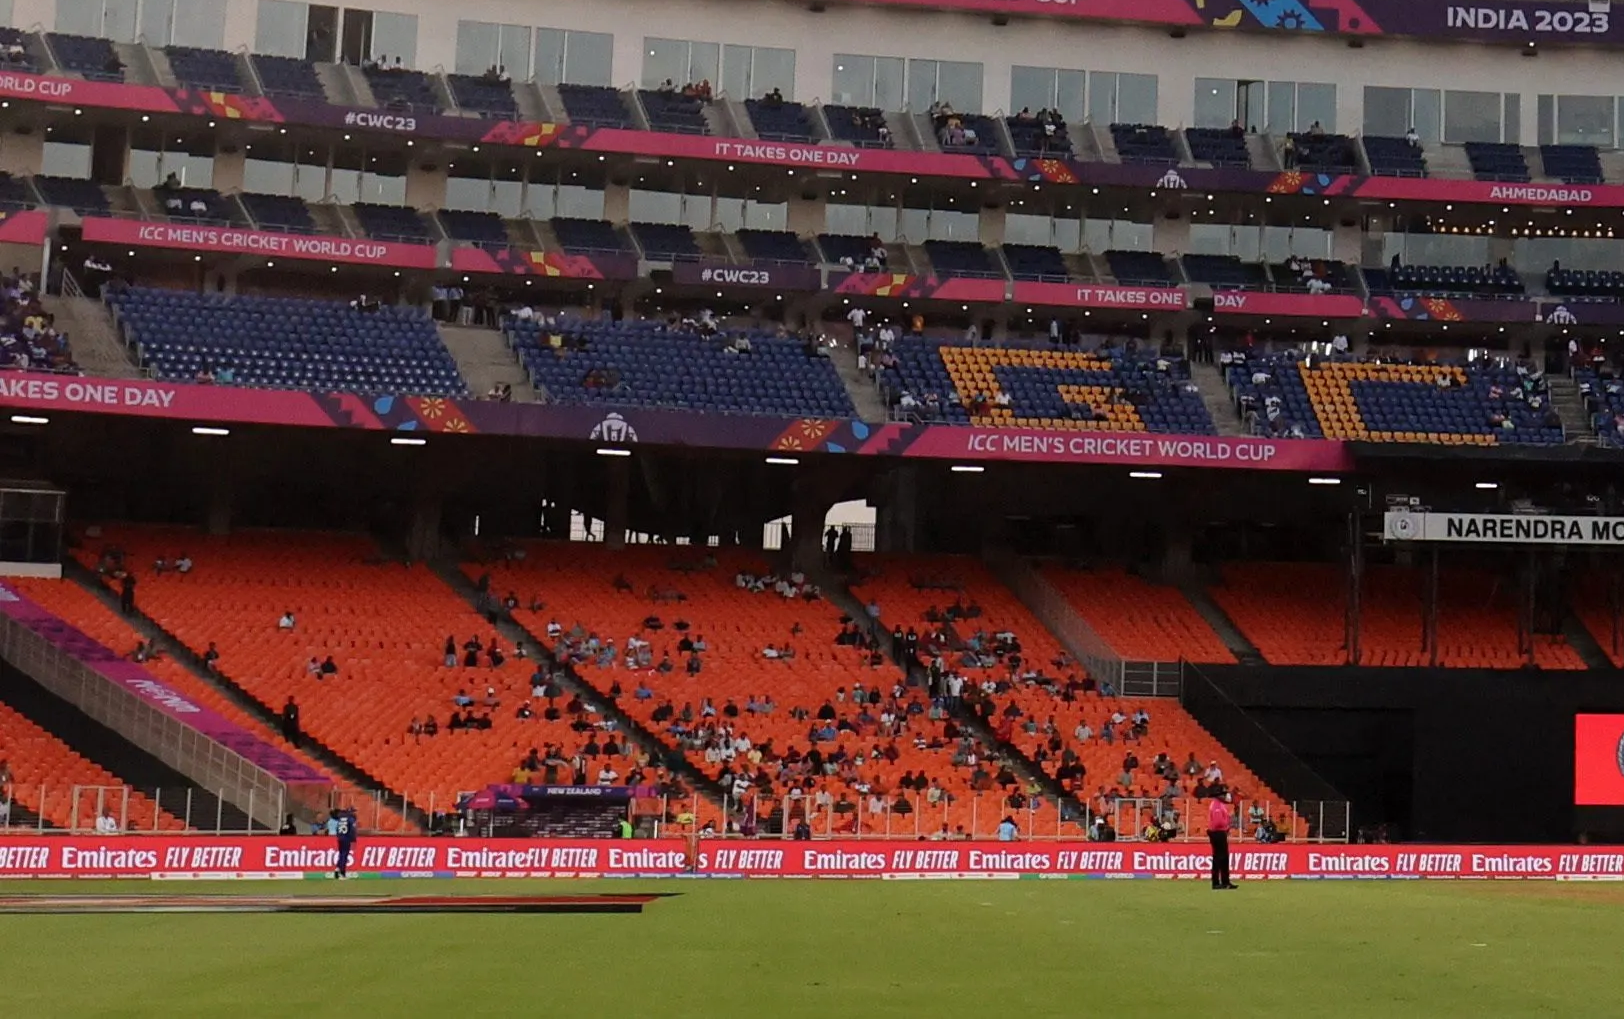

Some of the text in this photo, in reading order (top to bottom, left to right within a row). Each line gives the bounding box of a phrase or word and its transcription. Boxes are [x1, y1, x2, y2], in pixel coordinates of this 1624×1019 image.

[1446, 6, 1610, 34] INDIA 2023
[38, 81, 72, 97] CUP
[344, 112, 417, 131] #CWC23
[715, 142, 860, 165] IT TAKES ONE DAY
[1490, 185, 1592, 202] AHMEDABAD
[139, 226, 387, 259] ICC MEN'S CRICKET WORLD CUP
[701, 268, 770, 284] #CWC23
[1076, 289, 1247, 308] IT TAKES ONE DAY
[65, 383, 118, 405] ONE
[124, 387, 175, 408] DAY
[967, 434, 1276, 462] ICC MEN'S CRICKET WORLD CUP
[1446, 517, 1583, 541] NARENDRA
[61, 846, 243, 869] Emirates FLY BETTER
[361, 847, 383, 868] FLY
[388, 847, 436, 868] BETTER
[527, 847, 550, 868] FLY
[550, 848, 598, 868] BETTER
[608, 848, 784, 869] Emirates FLY BETTER
[804, 849, 959, 870] Emirates FLY BETTER
[969, 850, 1123, 870] Emirates FLY BETTER
[1133, 851, 1288, 871] Emirates LY BETTER
[1308, 852, 1462, 872] Emirates FLY BETTER
[1471, 853, 1624, 873] Emirates FLY BETTER
